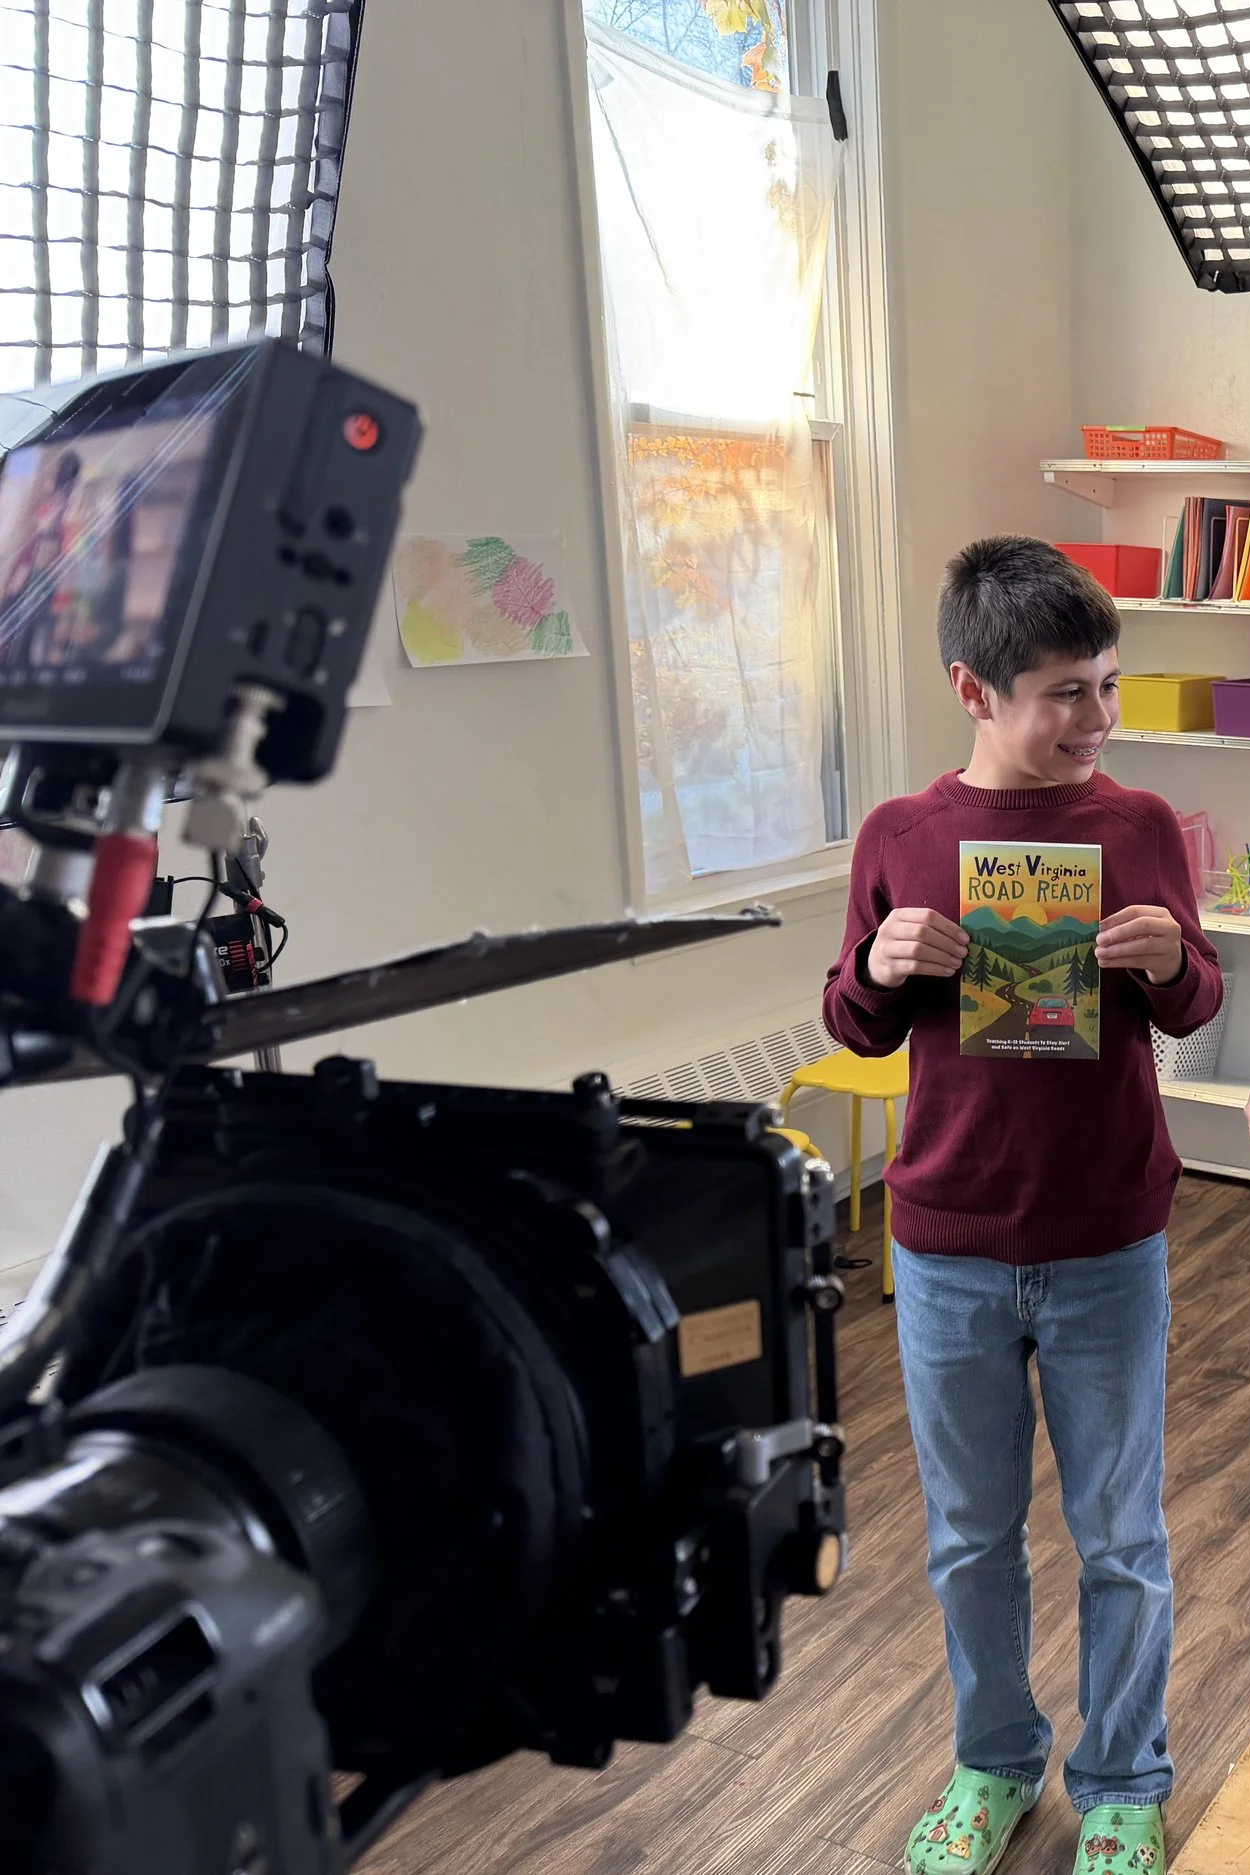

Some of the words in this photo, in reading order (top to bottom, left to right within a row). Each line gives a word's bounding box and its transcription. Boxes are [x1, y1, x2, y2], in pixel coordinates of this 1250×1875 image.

[974, 856, 1021, 877] West
[1025, 854, 1086, 882] Virginia
[968, 876, 1024, 901] ROAD
[1036, 879, 1093, 903] READY
